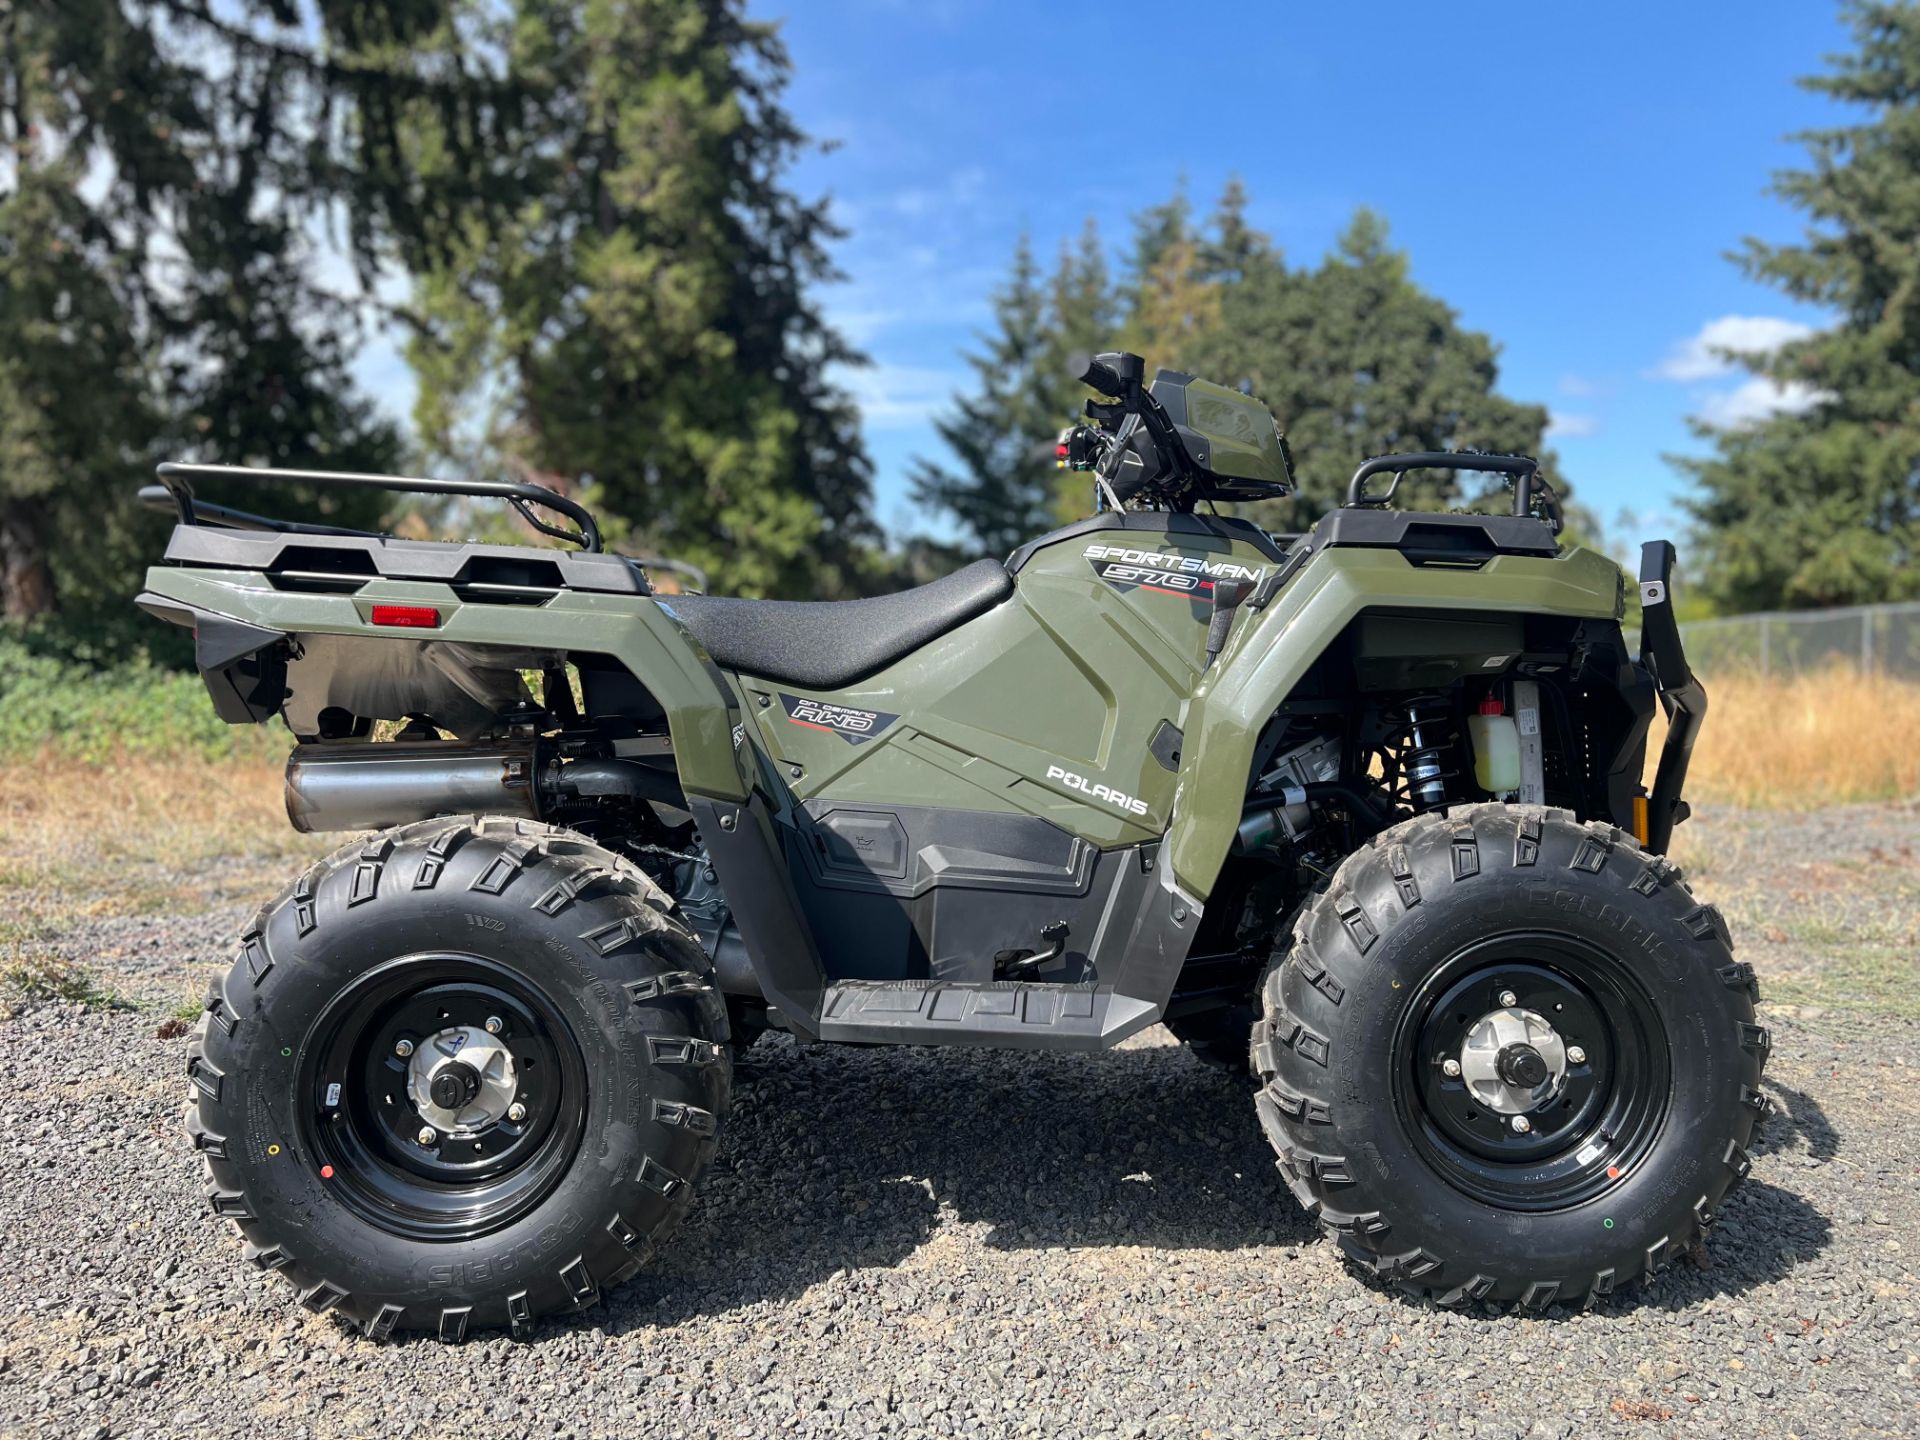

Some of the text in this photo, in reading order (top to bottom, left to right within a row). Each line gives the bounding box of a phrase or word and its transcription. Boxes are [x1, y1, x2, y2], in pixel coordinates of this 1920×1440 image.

[1082, 545, 1261, 581] SPORTSMAN
[1102, 563, 1199, 590] 570
[791, 706, 873, 732] AWD
[1046, 765, 1149, 816] POLARIS
